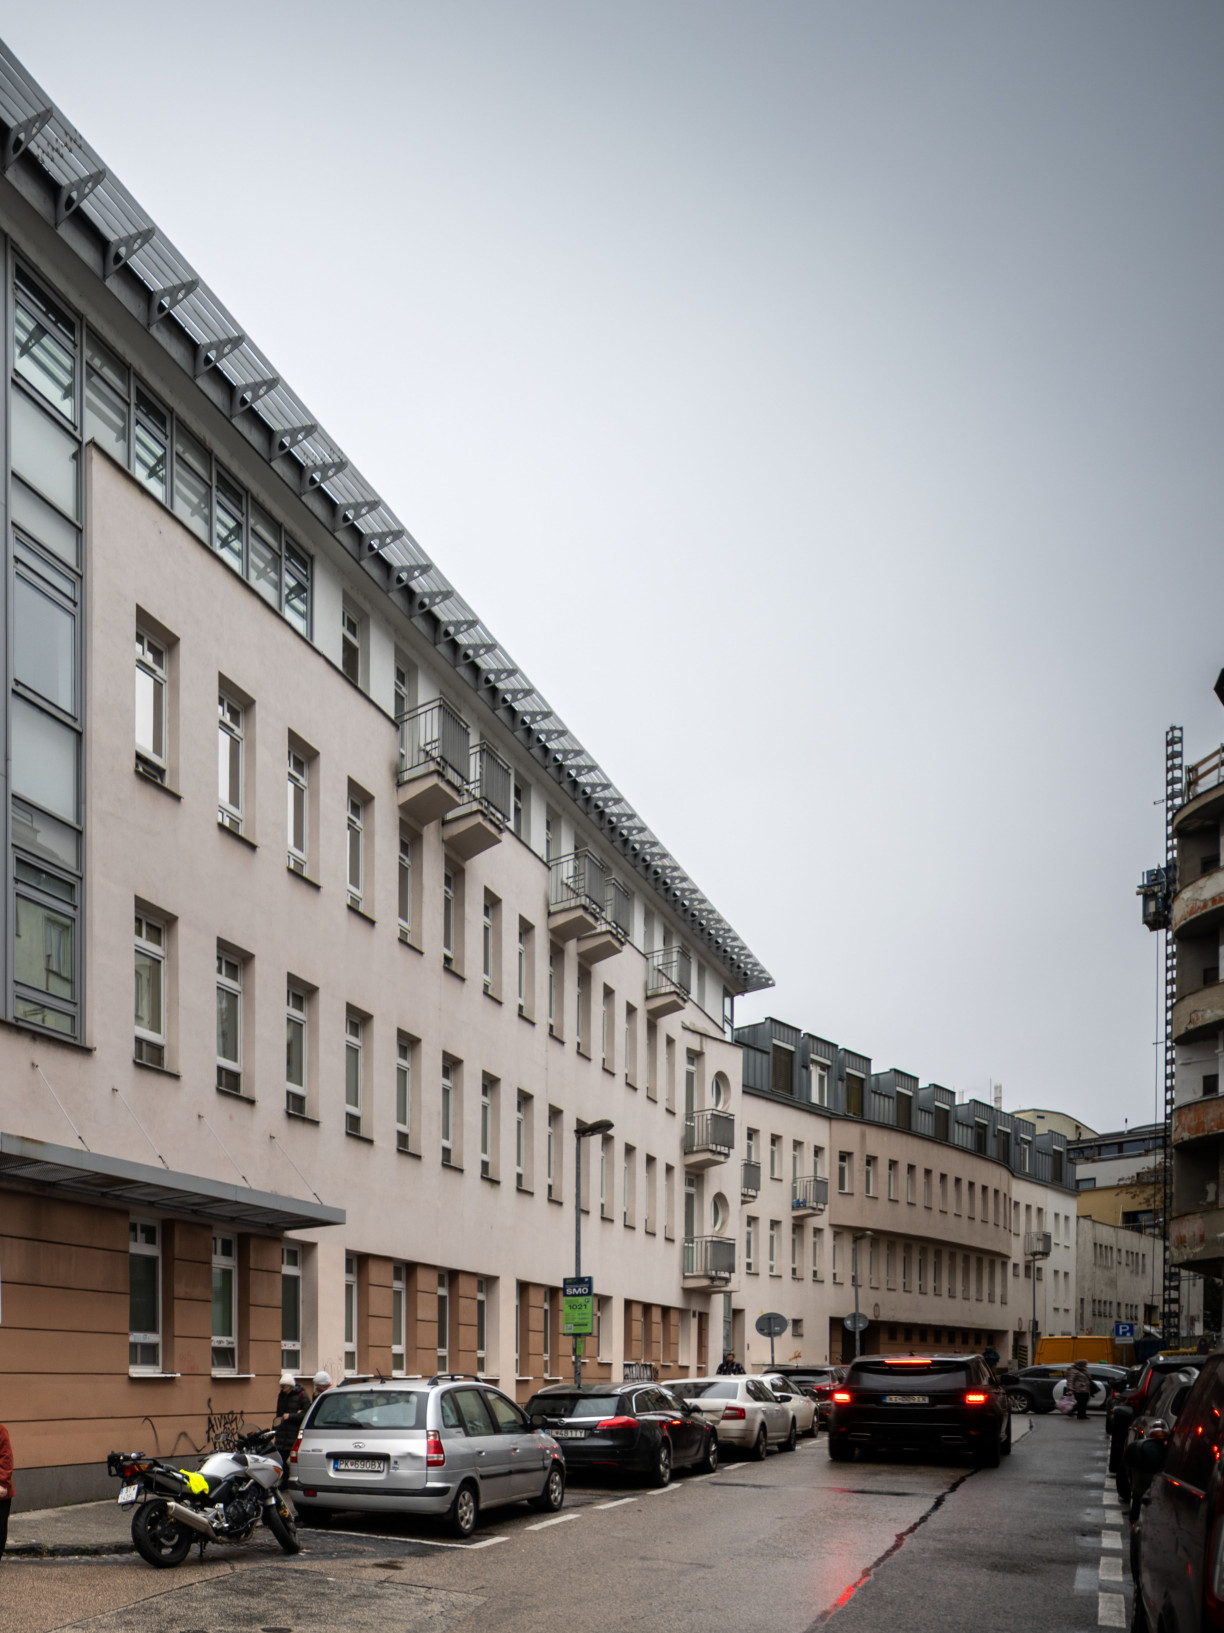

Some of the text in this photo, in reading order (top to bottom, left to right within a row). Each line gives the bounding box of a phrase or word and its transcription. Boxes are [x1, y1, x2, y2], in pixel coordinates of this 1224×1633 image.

[1119, 1324, 1130, 1335] P
[339, 1459, 382, 1470] PK 690BX
